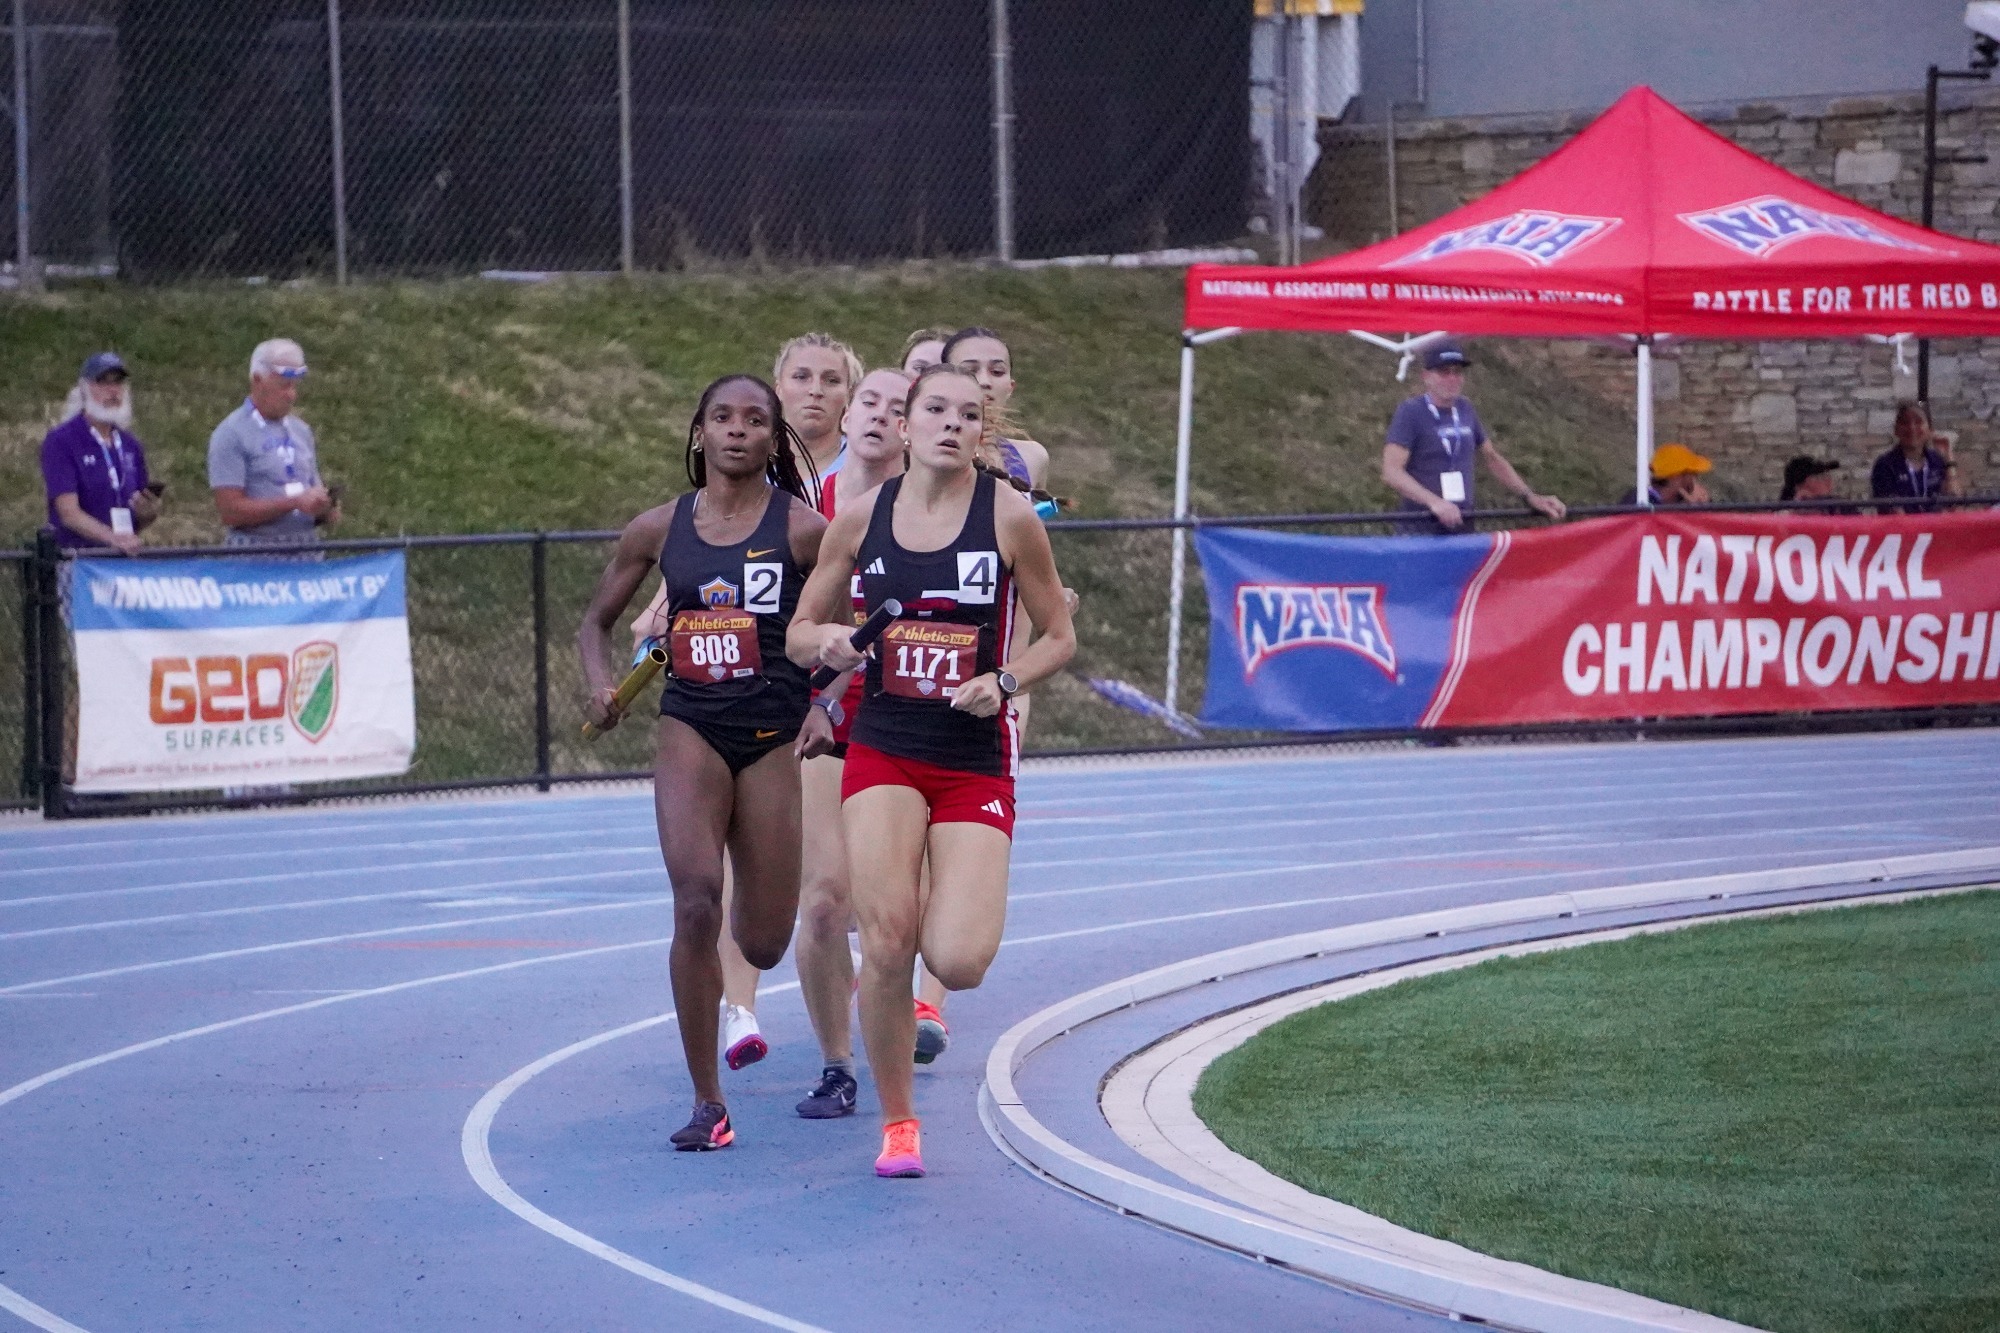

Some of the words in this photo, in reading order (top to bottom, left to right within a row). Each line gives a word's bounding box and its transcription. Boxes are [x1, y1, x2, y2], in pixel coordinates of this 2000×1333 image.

[1202, 280, 1269, 297] NATIONAL
[1274, 281, 1367, 299] ASSOCIATION
[1370, 283, 1390, 299] OF
[1802, 286, 1851, 313] FOR
[1862, 284, 1911, 310] THE
[1921, 283, 1971, 309] RED
[963, 557, 994, 595] 4
[1637, 533, 1942, 605] NATIONAL
[222, 581, 297, 606] TRACK
[298, 576, 358, 601] BUILT
[750, 569, 778, 605] 2
[1235, 583, 1396, 680] NAIA
[690, 634, 740, 665] 808
[896, 645, 960, 680] 1171
[1562, 611, 2000, 696] CHAMPIONSHI
[165, 725, 286, 752] SURFACES
